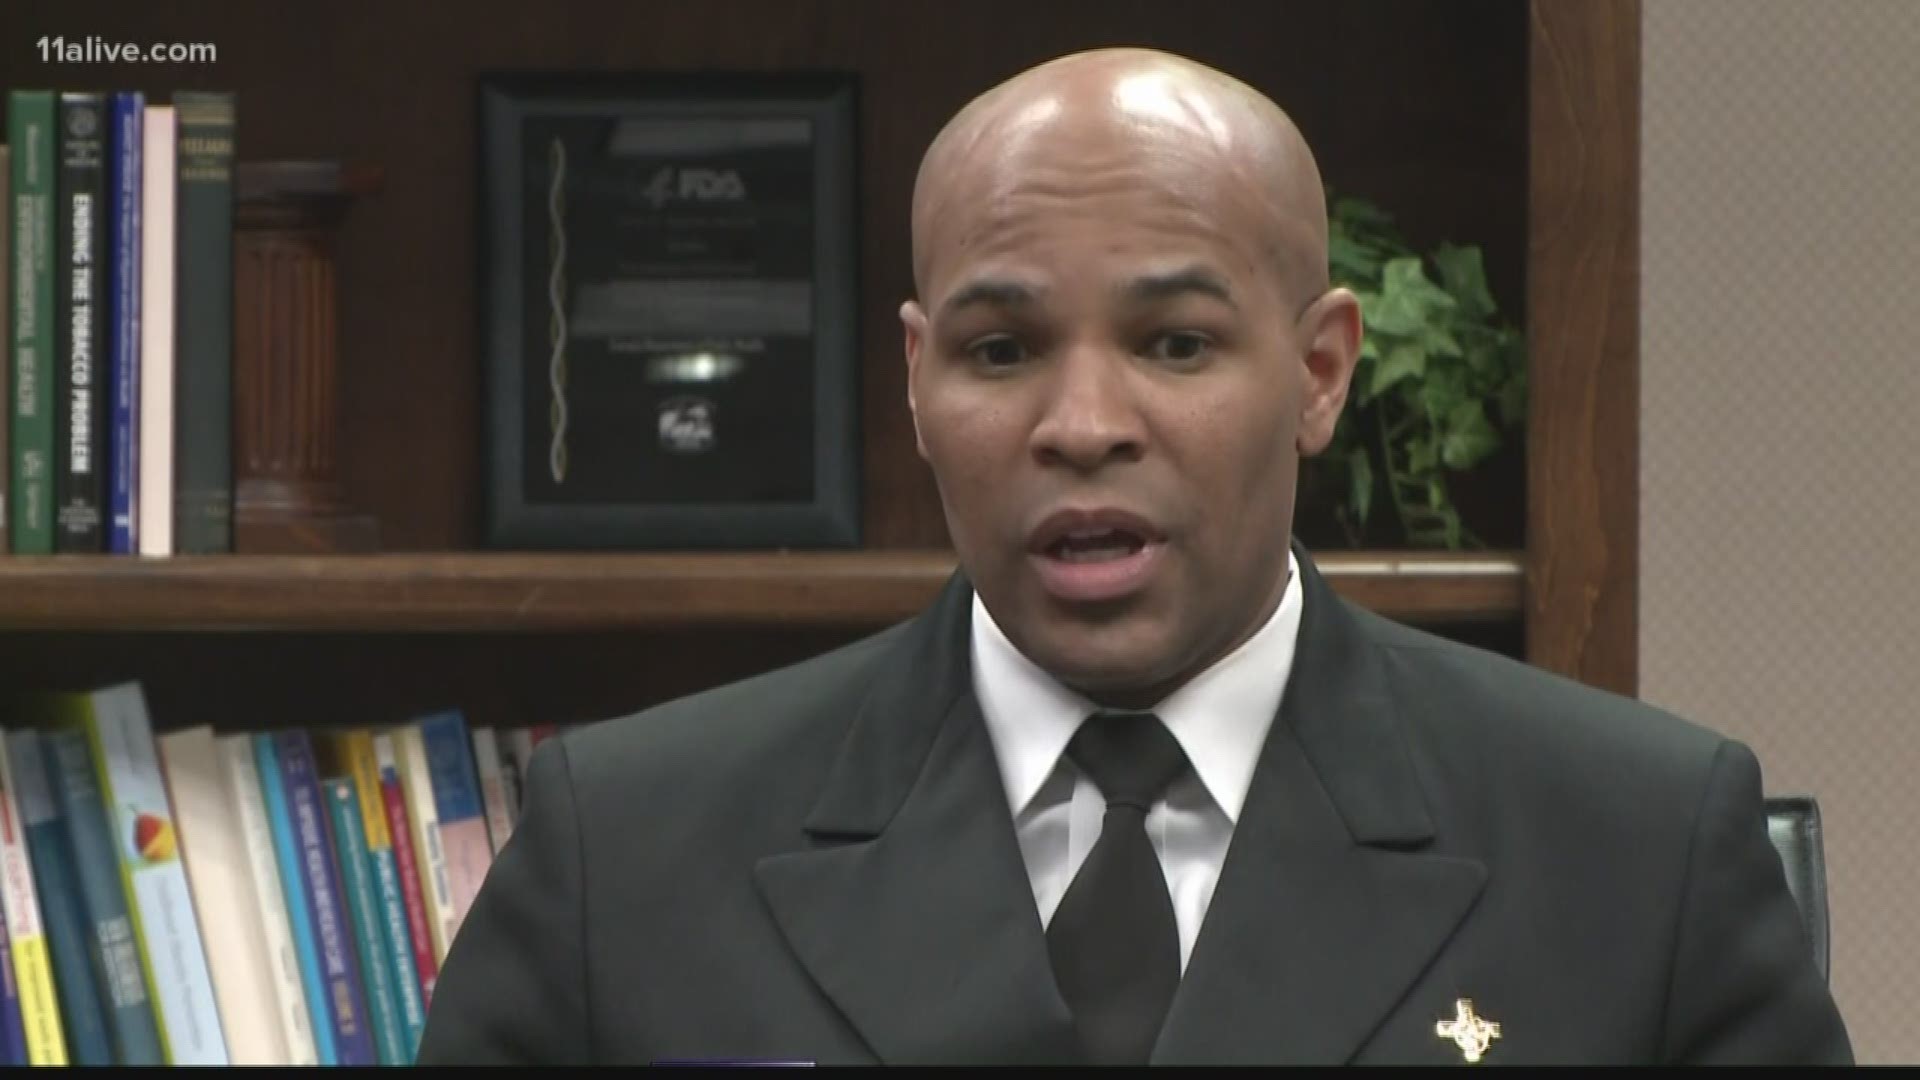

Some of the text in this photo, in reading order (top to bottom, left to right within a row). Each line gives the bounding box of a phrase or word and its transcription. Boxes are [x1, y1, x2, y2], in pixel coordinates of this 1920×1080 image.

[678, 169, 746, 200] FDA
[71, 193, 92, 474] ENDING THE TOBACCO PROBLEM
